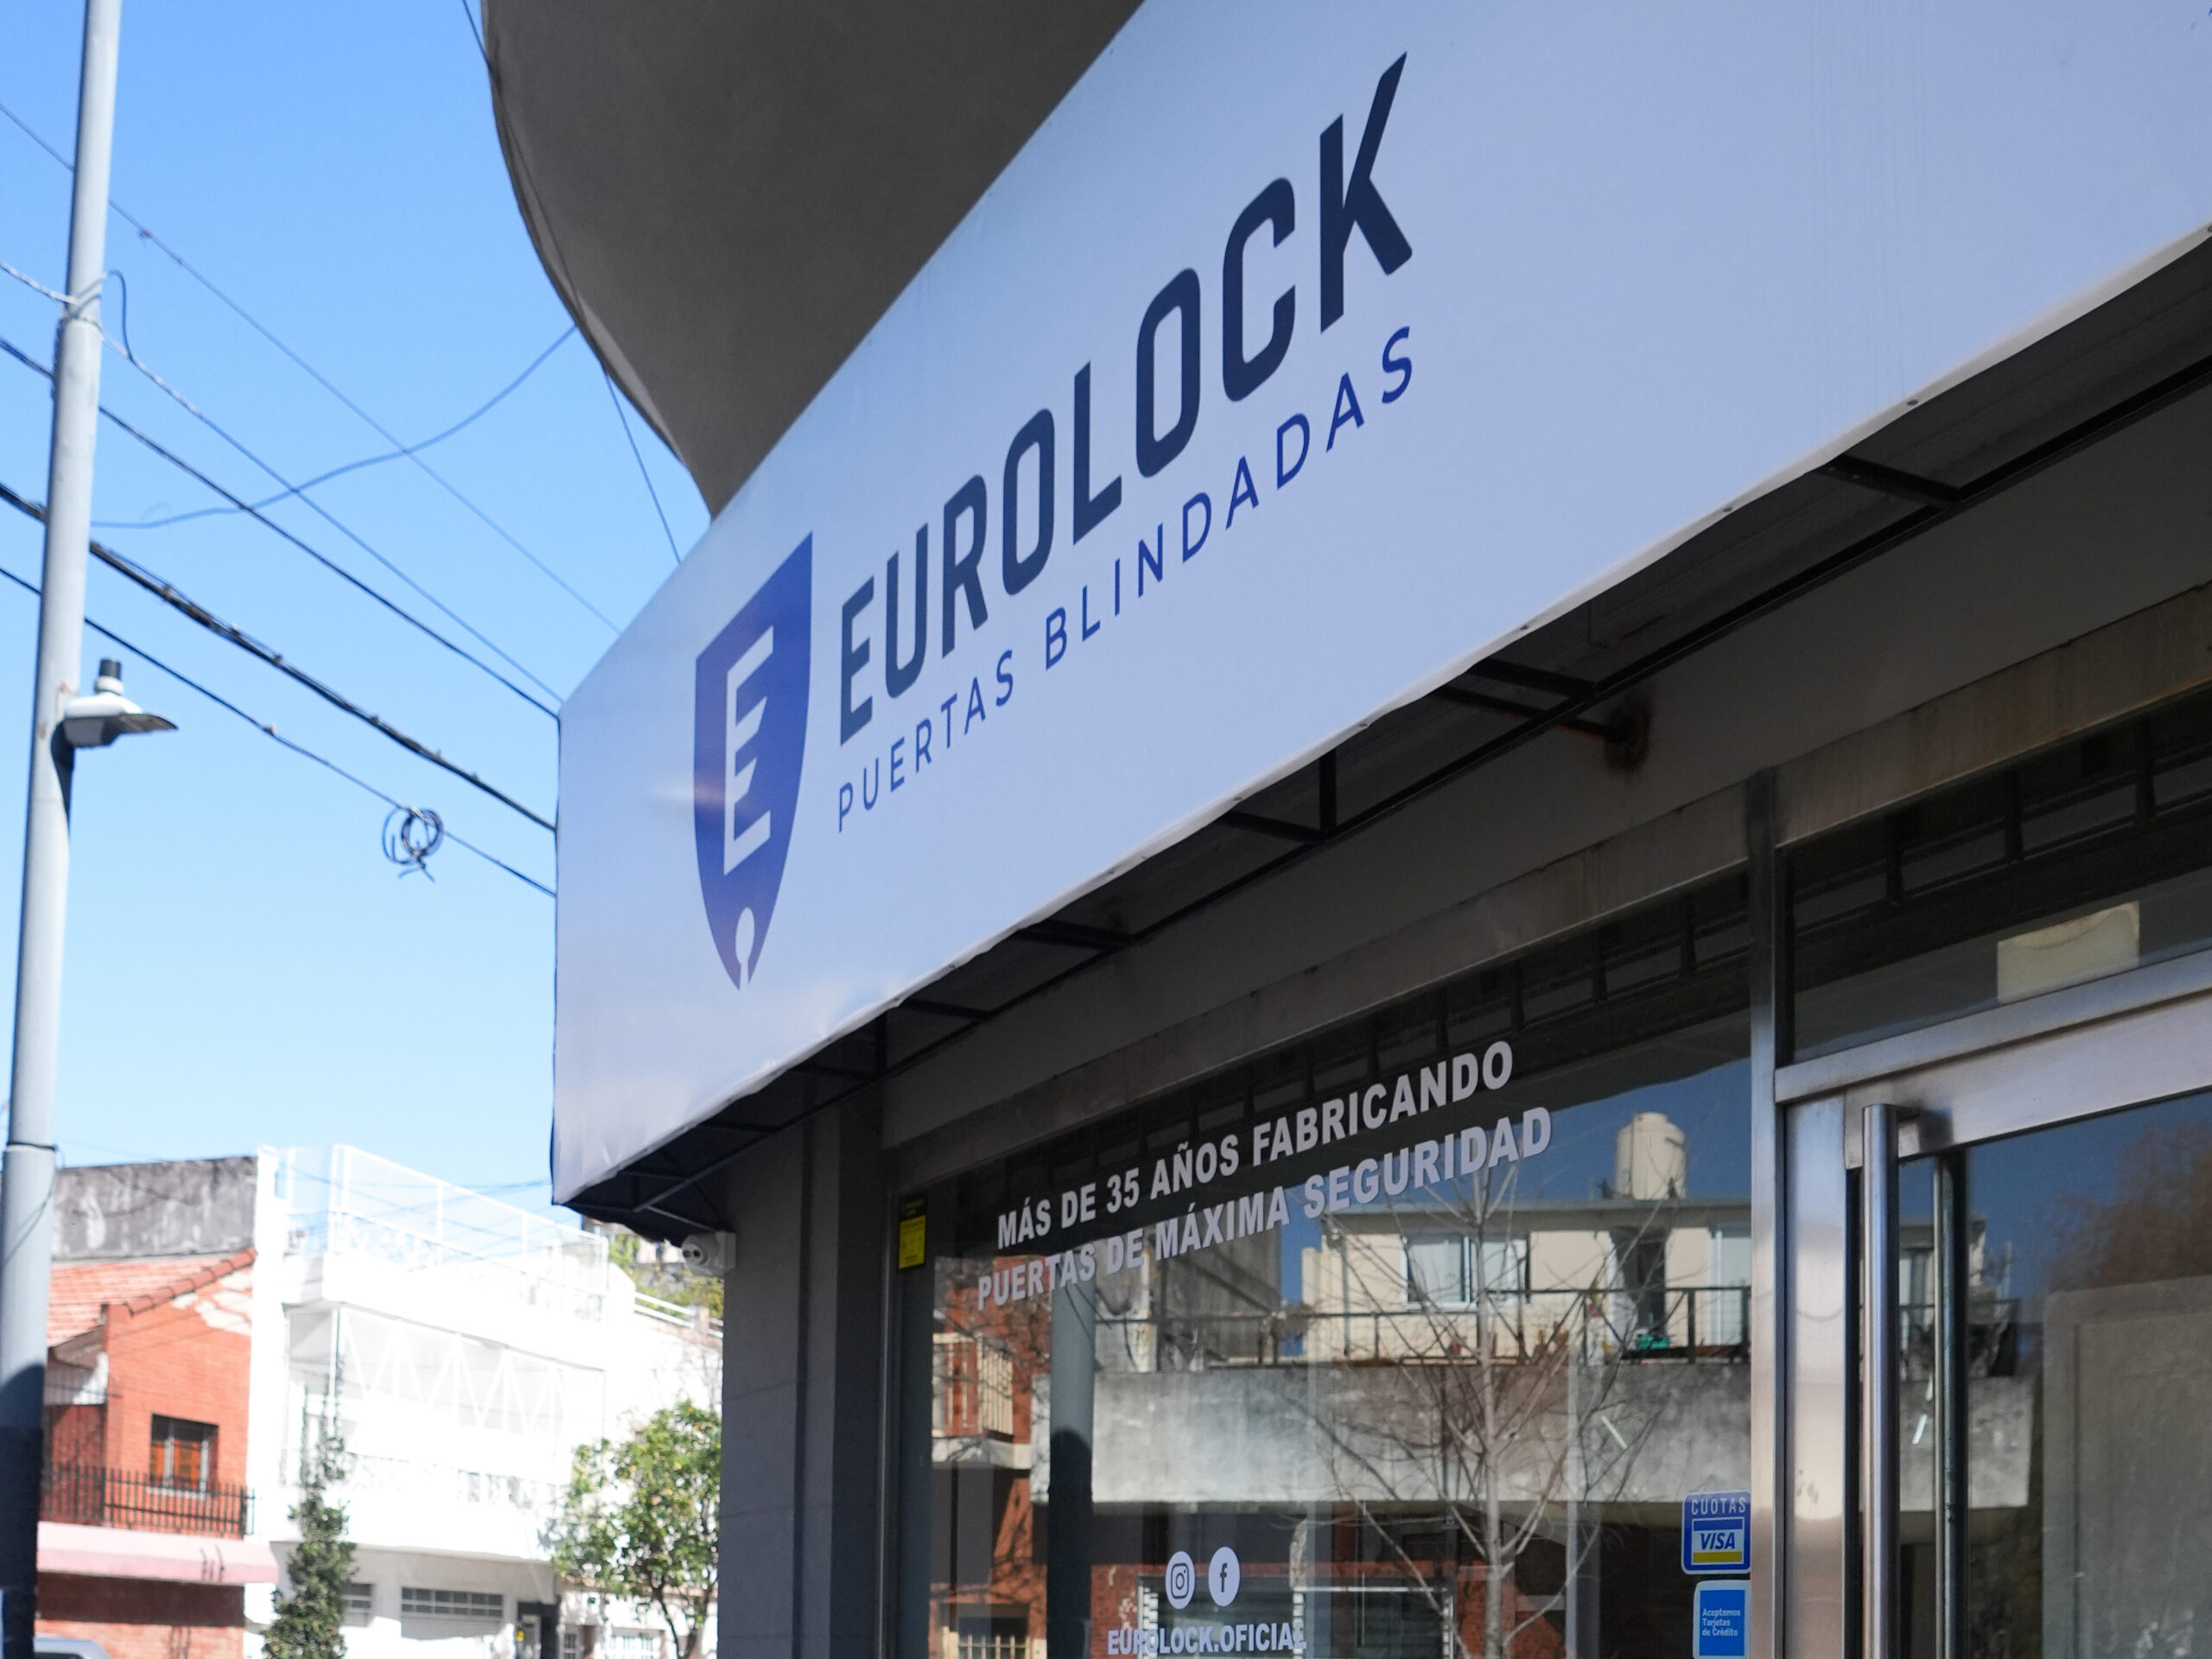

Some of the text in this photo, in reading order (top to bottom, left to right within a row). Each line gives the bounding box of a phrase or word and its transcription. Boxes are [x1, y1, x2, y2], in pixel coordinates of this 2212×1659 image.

[841, 51, 1413, 747] EUROLOCK
[838, 326, 1413, 832] PUERTAS BLINDADAS
[997, 1040, 1513, 1249] MÁS DE 35 AÑOS FABRICANDO
[977, 1106, 1552, 1312] PUERTAS DE MÁXIMA SEGURIDAD
[1691, 1497, 1746, 1516] CUOTAS
[1699, 1532, 1736, 1550] VISA
[1702, 1608, 1741, 1618] Aceptamos
[1702, 1618, 1731, 1628] Tarjetas
[1107, 1622, 1307, 1656] EUROLOCK.OFICIAL
[1701, 1626, 1738, 1637] de Crédito
